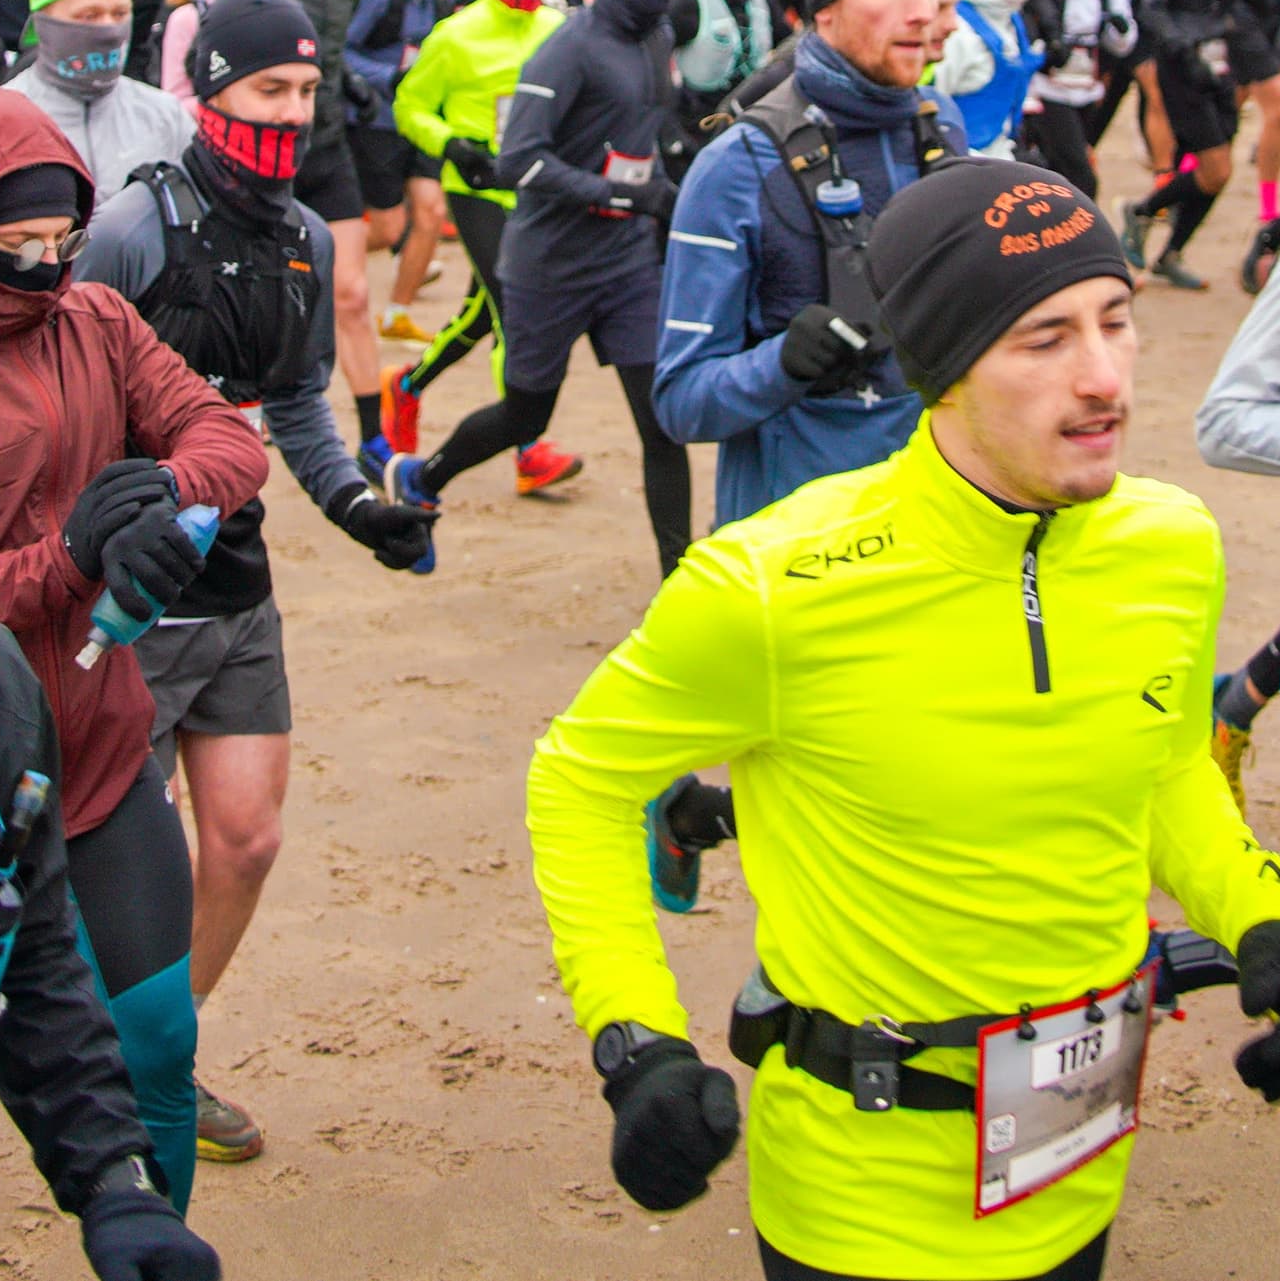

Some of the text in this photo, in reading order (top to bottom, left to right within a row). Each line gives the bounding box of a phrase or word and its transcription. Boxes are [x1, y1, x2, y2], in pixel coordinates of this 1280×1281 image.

[198, 103, 299, 180] RAIL
[984, 182, 1074, 229] CROSS
[1057, 1028, 1103, 1075] 1173
